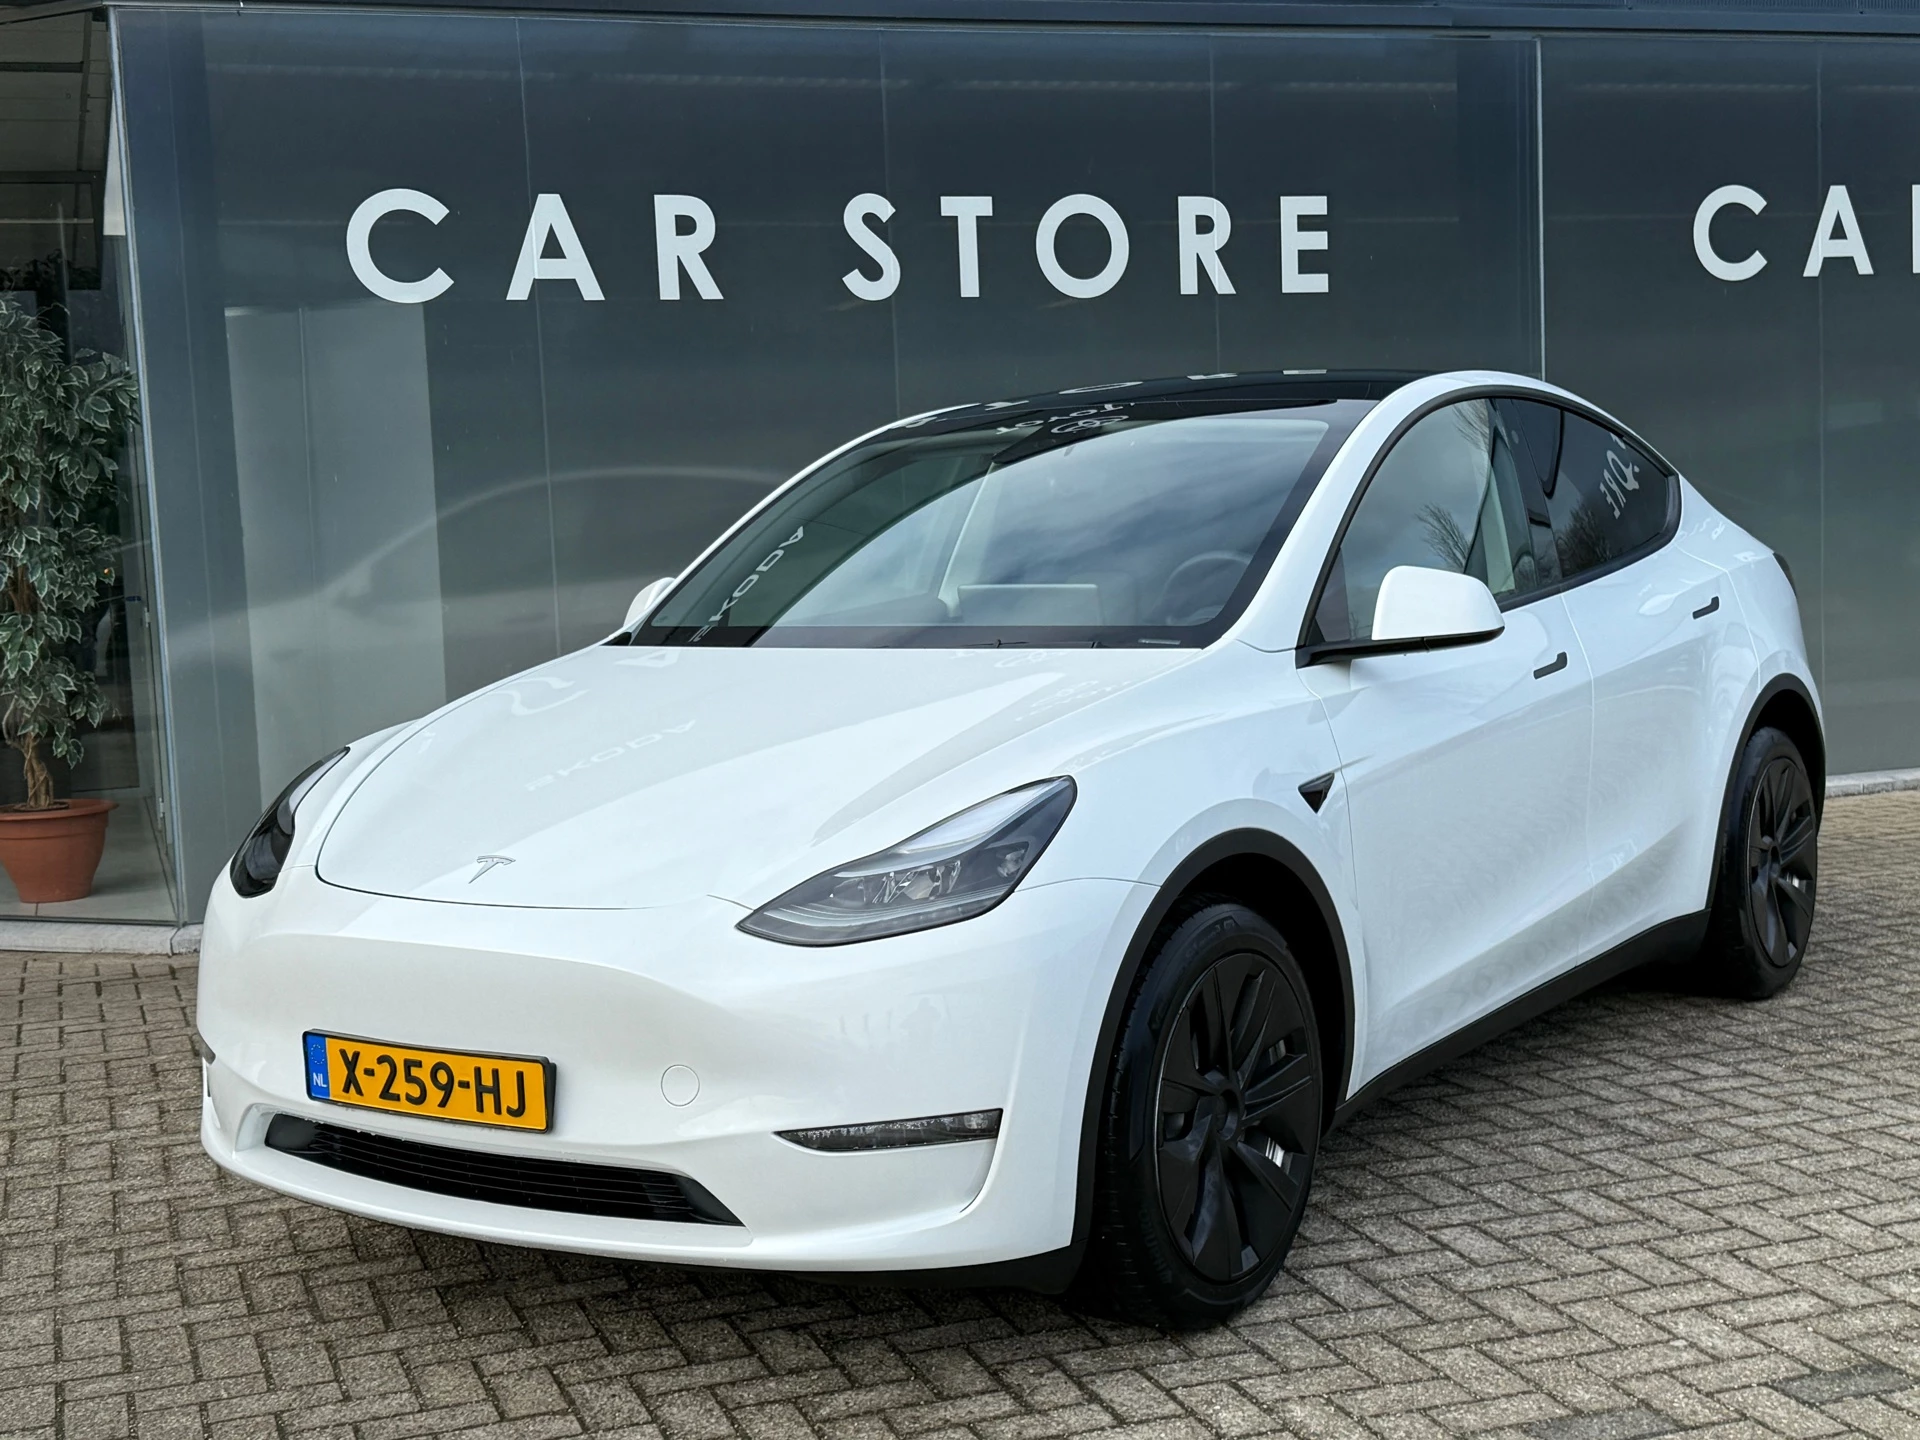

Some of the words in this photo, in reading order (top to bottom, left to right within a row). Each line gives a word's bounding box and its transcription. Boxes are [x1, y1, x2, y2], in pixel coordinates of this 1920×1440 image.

[346, 188, 724, 303] CAR
[842, 193, 1329, 301] STORE
[1693, 184, 1920, 282] CA
[313, 1072, 327, 1088] NL
[339, 1048, 526, 1118] X-259-HJ
